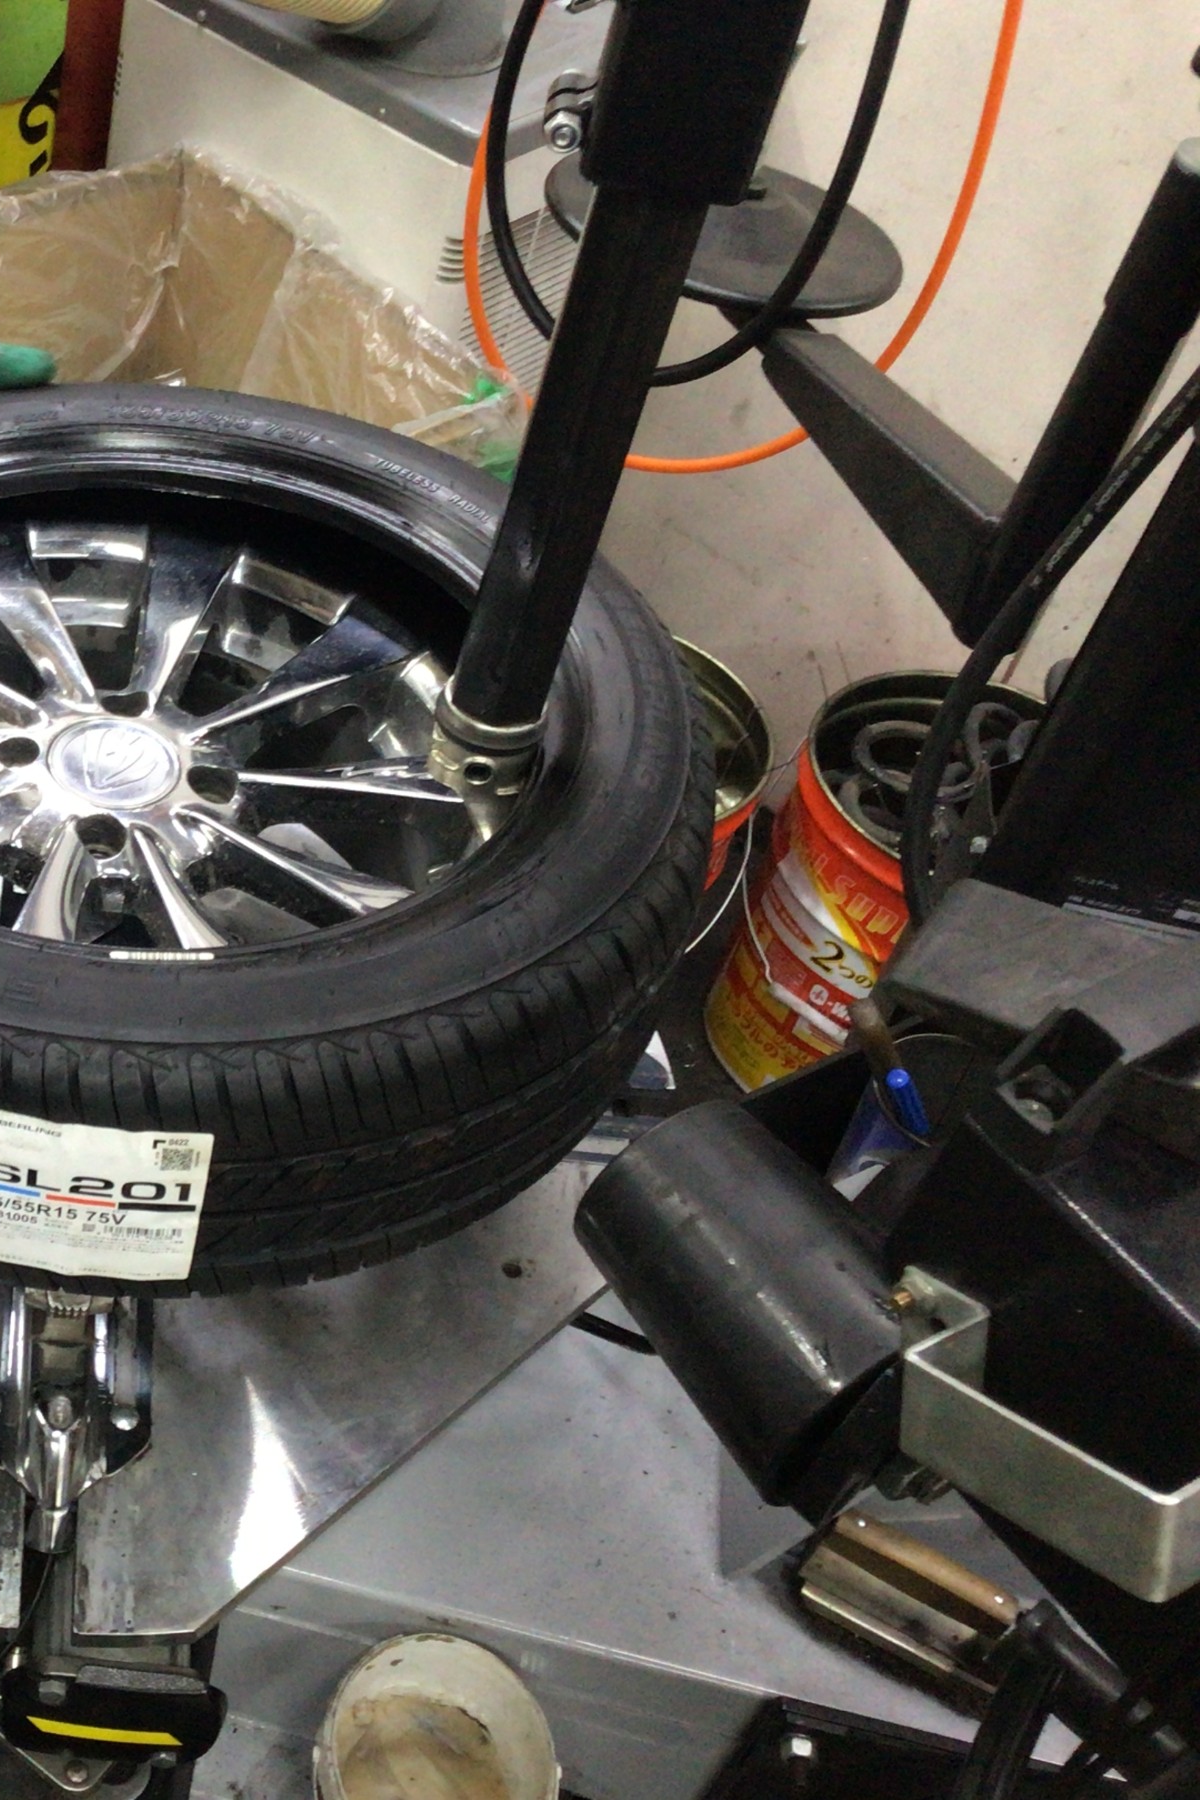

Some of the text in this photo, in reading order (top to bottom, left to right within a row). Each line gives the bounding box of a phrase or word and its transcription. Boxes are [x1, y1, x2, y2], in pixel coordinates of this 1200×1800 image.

[375, 457, 492, 525] TUBELESS RADIAL
[86, 1210, 127, 1226] 75V
